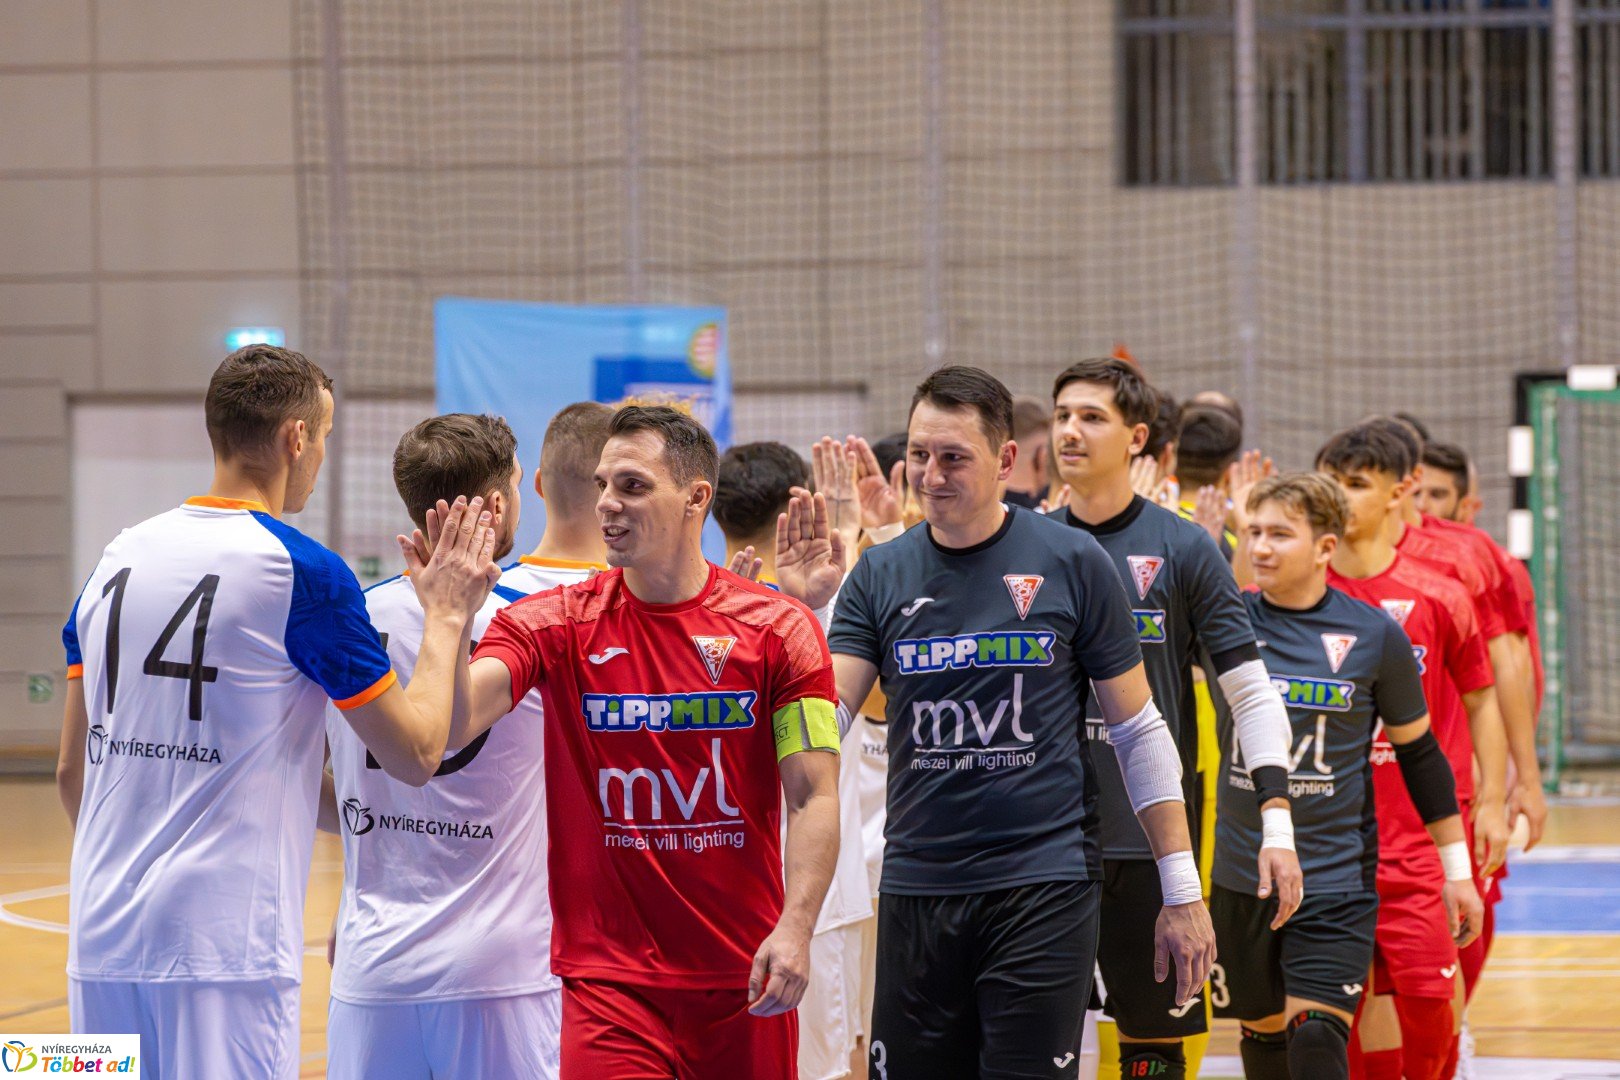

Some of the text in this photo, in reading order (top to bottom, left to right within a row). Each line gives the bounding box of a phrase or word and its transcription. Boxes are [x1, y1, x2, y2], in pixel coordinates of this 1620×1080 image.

[100, 566, 220, 722] 14
[912, 673, 1034, 746] mvl
[109, 738, 222, 763] NYÍREGYHÁZA
[910, 751, 1036, 770] mezei vill lighting
[598, 737, 740, 820] mvl
[379, 813, 494, 840] NYÍREGYHÁZA
[605, 829, 745, 853] mezei vill lighting
